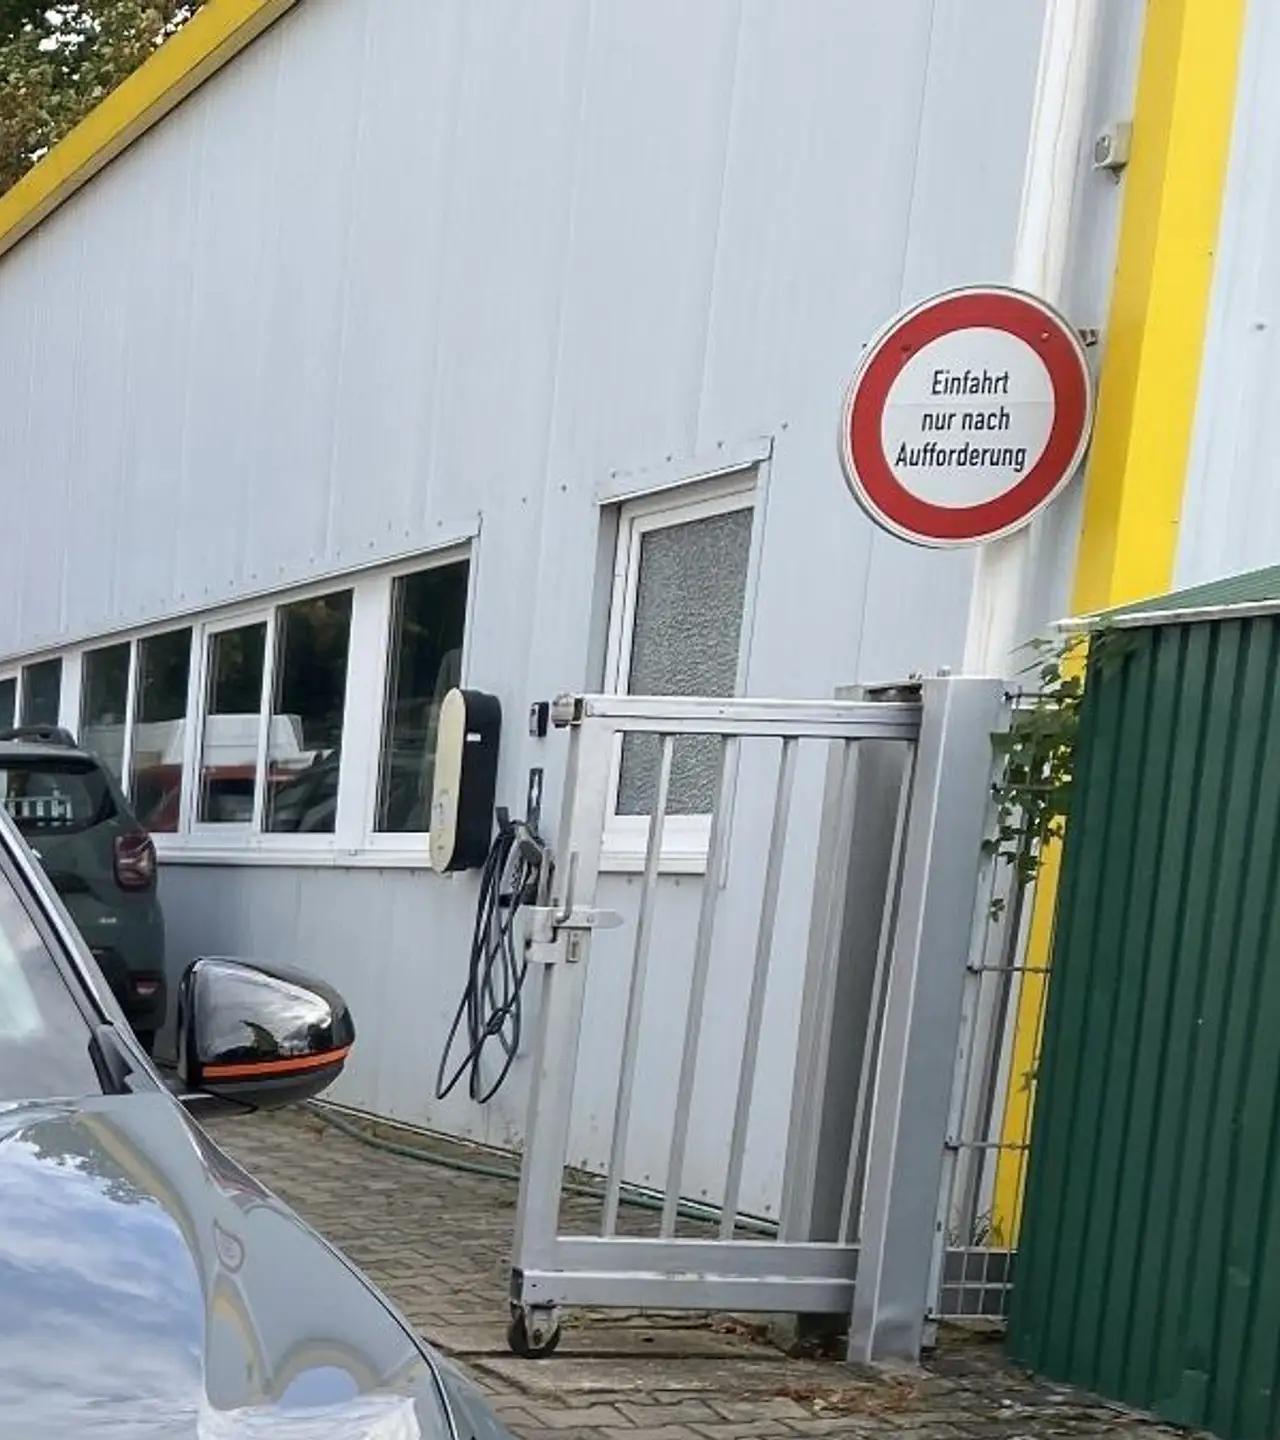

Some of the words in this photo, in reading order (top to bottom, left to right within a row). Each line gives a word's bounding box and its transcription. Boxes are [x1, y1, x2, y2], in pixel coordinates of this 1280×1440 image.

[931, 369, 1010, 395] Einfahrt
[921, 411, 955, 431] nur
[962, 406, 1011, 430] nach
[895, 442, 1027, 472] Aufforderung
